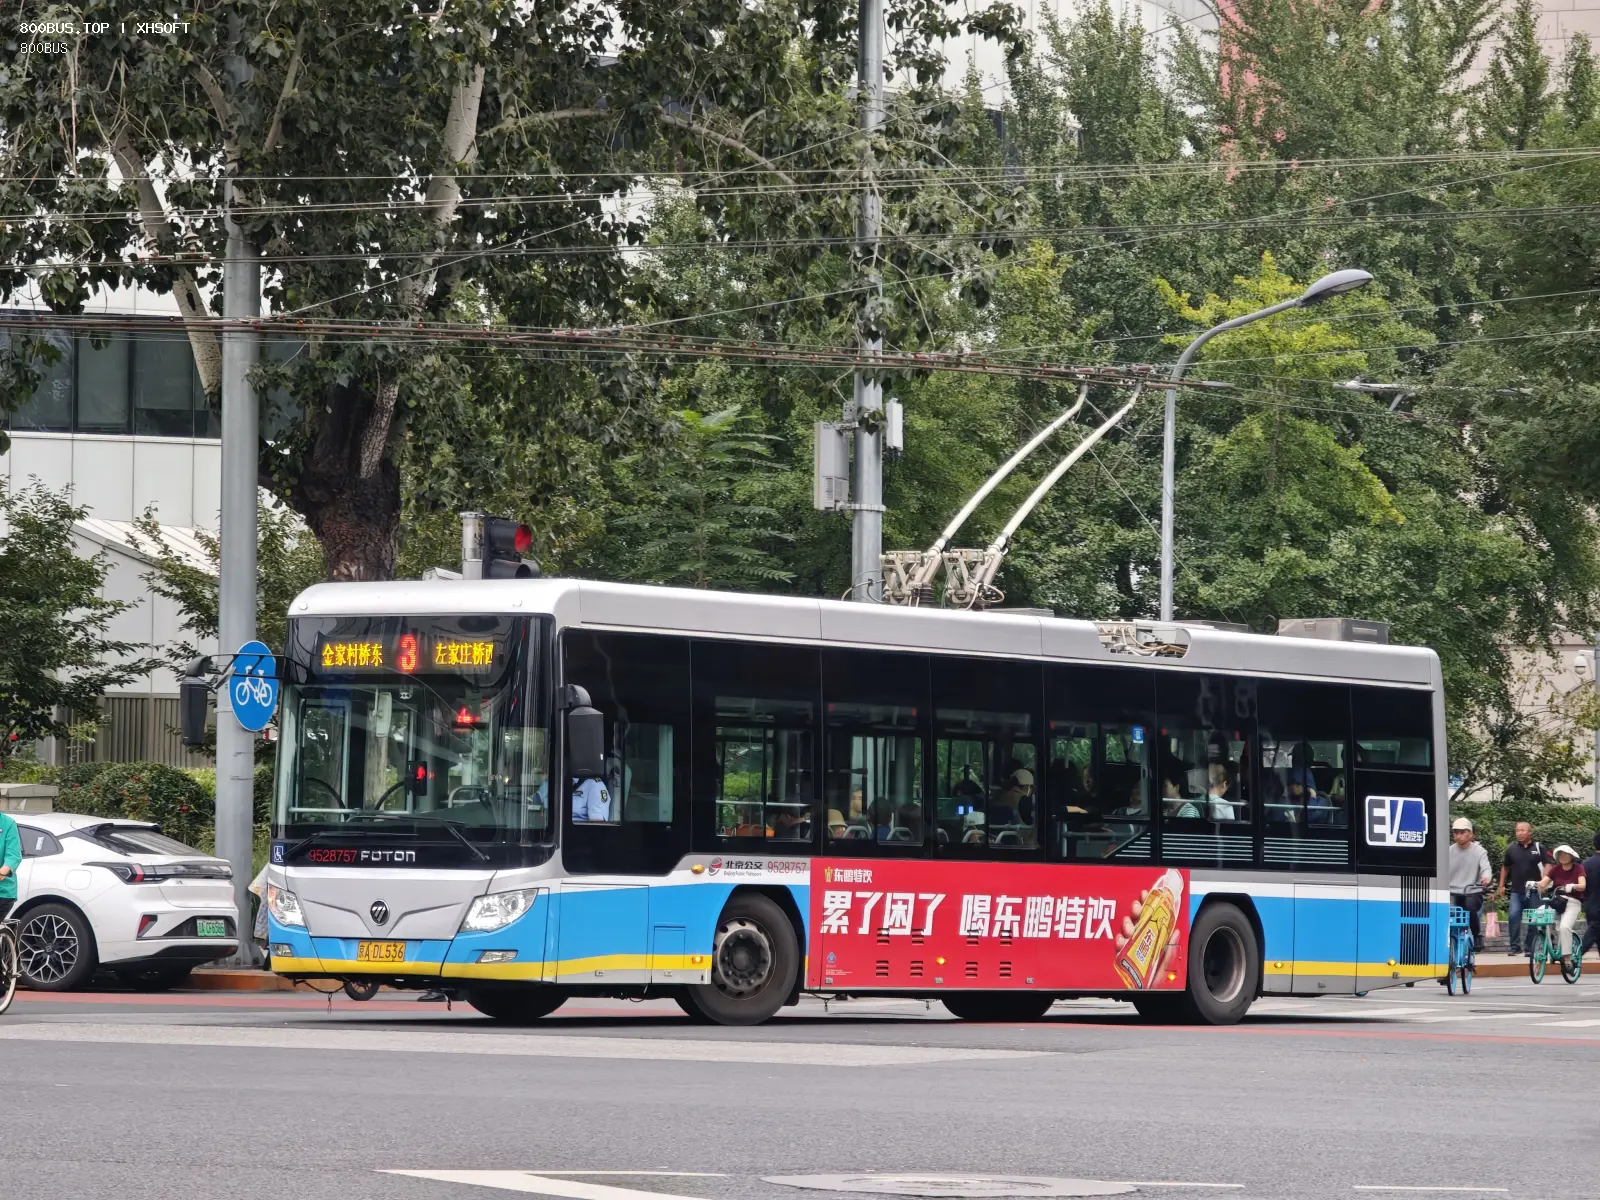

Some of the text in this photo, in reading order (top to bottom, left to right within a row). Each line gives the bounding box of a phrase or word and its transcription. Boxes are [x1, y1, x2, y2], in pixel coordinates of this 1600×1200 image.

[322, 643, 383, 667] 金家村桥东
[400, 635, 417, 671] 3
[1366, 797, 1406, 845] EV
[308, 849, 358, 862] 9528757
[360, 850, 416, 862] FOTON
[725, 860, 764, 870] 北京公交
[833, 867, 873, 884] 东鹏特饮
[820, 889, 1117, 940] 累了困了 喝东鹏特饮
